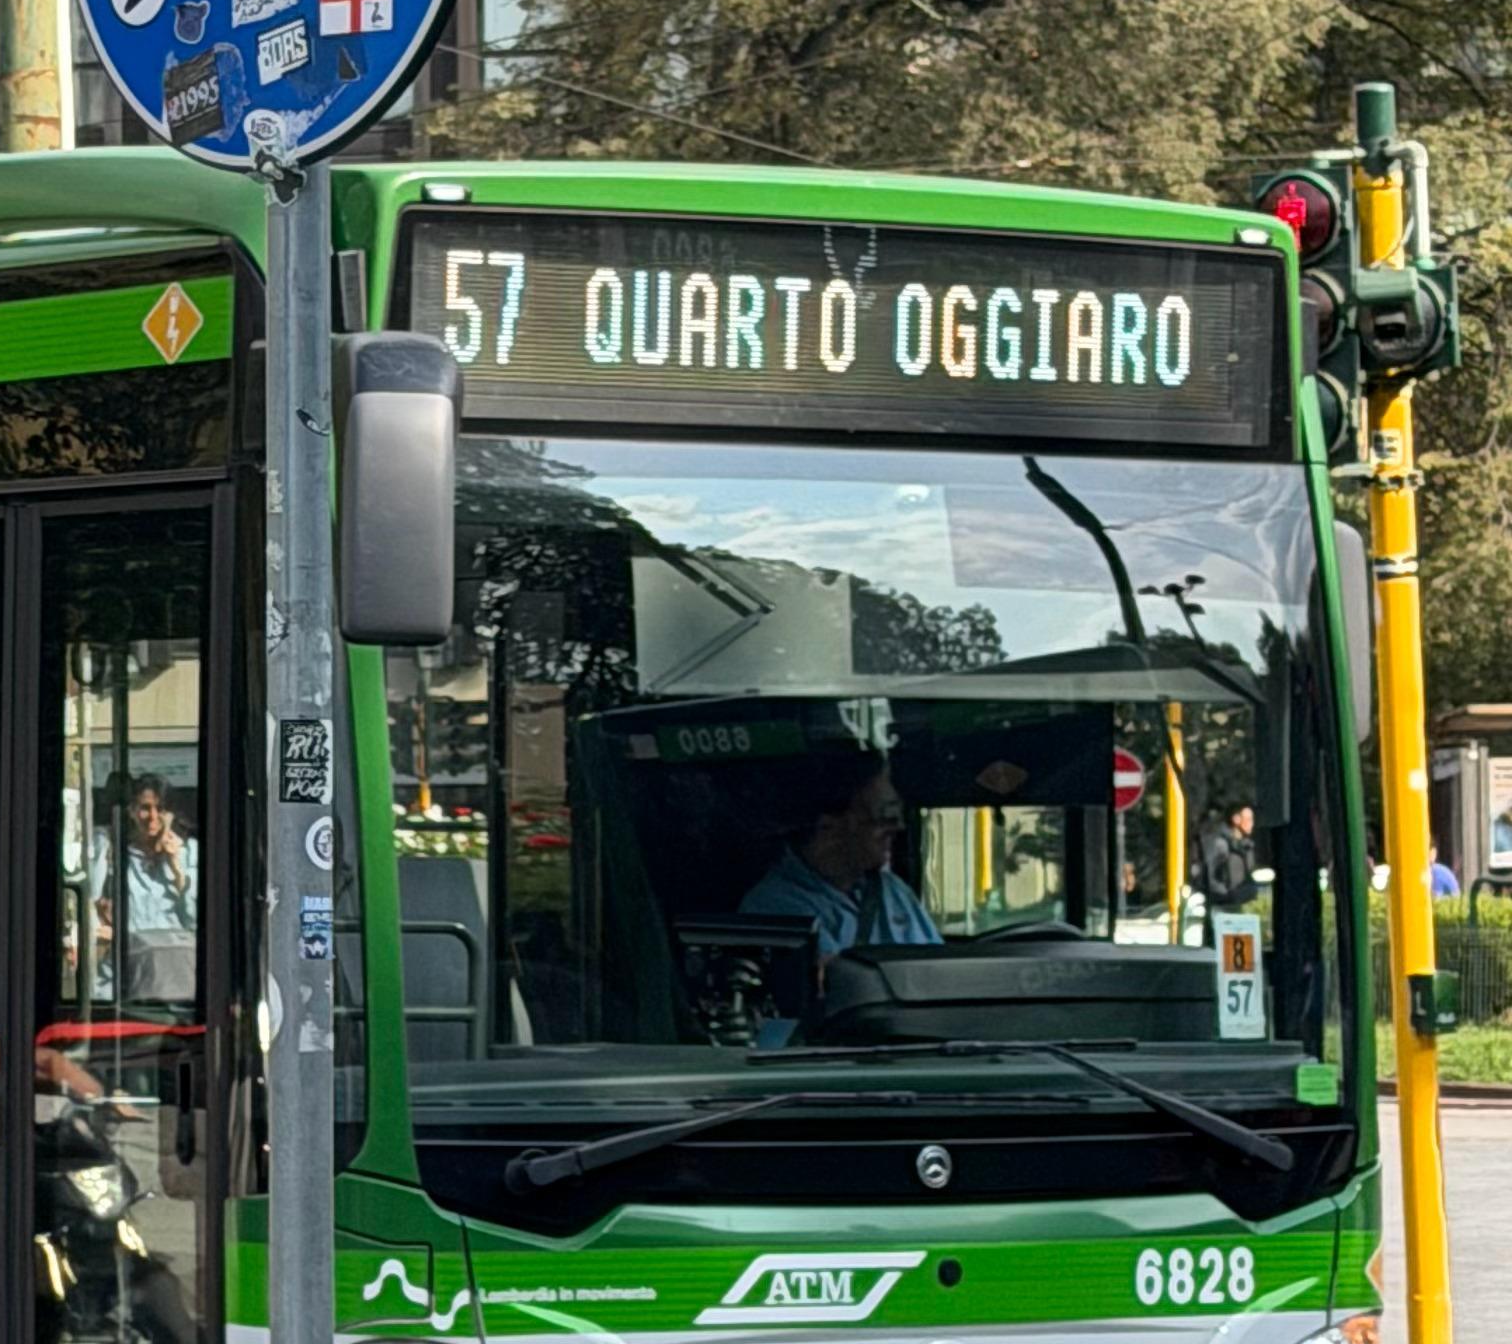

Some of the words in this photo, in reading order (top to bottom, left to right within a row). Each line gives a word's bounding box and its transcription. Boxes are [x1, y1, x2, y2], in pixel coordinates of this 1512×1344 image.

[444, 250, 525, 365] 57
[583, 266, 857, 373] QUARTO
[896, 282, 1192, 387] OGGIARO
[1233, 935, 1246, 973] 8
[1227, 979, 1254, 1017] 57
[764, 1269, 855, 1305] ATM
[1135, 1245, 1255, 1306] 6828
